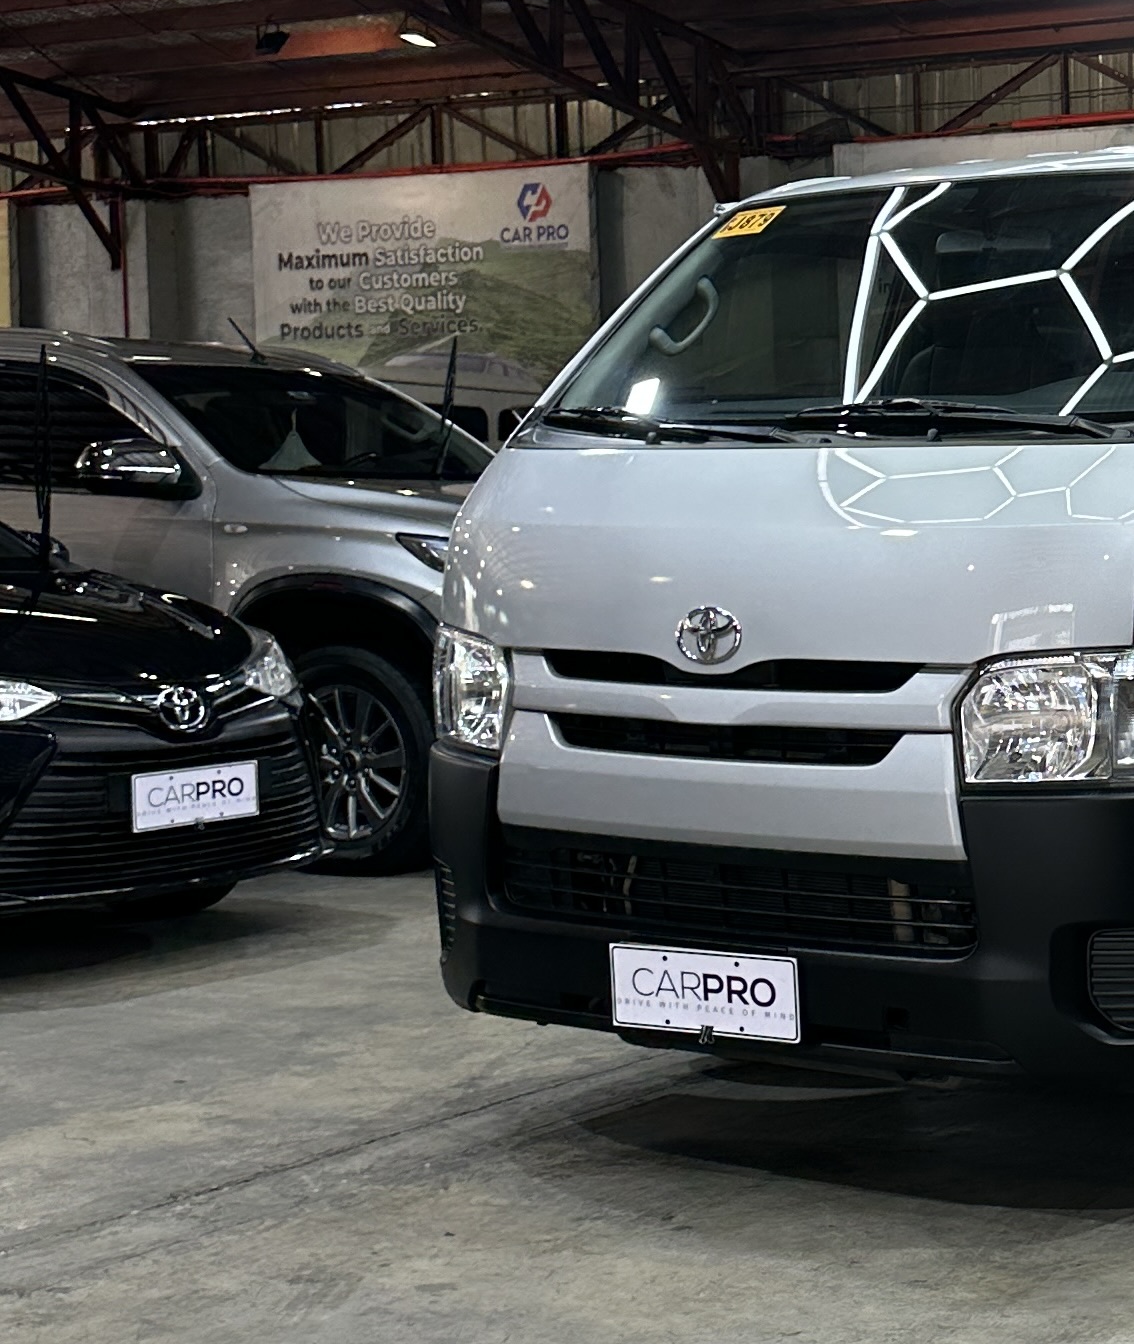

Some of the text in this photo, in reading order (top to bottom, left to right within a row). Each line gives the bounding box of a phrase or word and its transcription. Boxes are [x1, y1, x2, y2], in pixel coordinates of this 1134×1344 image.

[317, 214, 436, 245] We Provide
[501, 224, 569, 243] CAR PRO
[278, 243, 484, 271] Maximum Satisfaction
[309, 271, 458, 290] to our Customers
[290, 290, 466, 315] with the Best Quality
[280, 315, 483, 340] Products and Services.
[148, 777, 244, 807] CARPRO
[632, 968, 776, 1007] CARPRO
[697, 1004, 734, 1016] PEACE
[742, 1008, 756, 1017] OF
[765, 1011, 795, 1021] MIND
